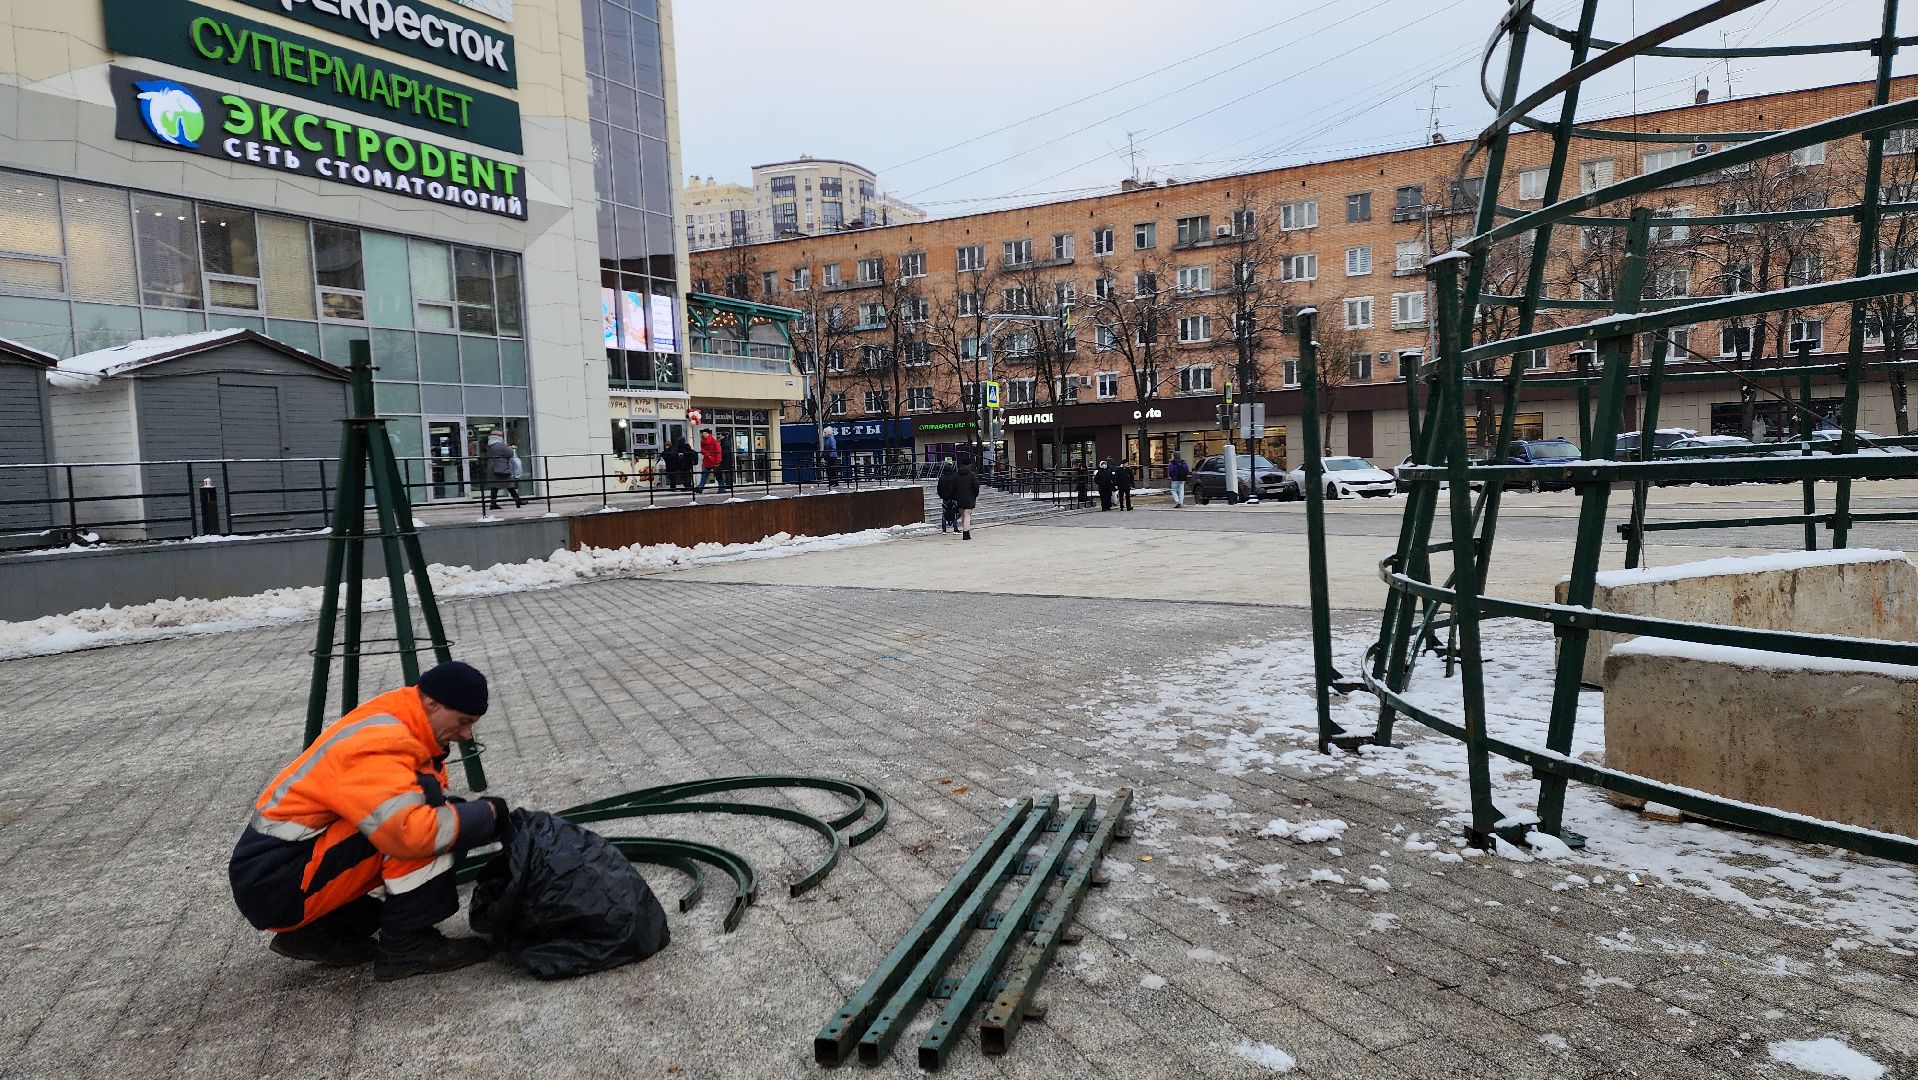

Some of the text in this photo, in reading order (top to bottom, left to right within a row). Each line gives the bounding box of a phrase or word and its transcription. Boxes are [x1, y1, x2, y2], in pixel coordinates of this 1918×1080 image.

[189, 16, 474, 128] СУПЕРМАРКЕТ
[222, 94, 518, 196] ЭКСТРОDENT
[223, 137, 523, 216] СЕТЬ СТОМАТОЛОГИЙ
[609, 401, 627, 410] УРМА
[659, 402, 684, 410] ВЫПЕЧКА
[818, 425, 882, 436] ВЕТЫ
